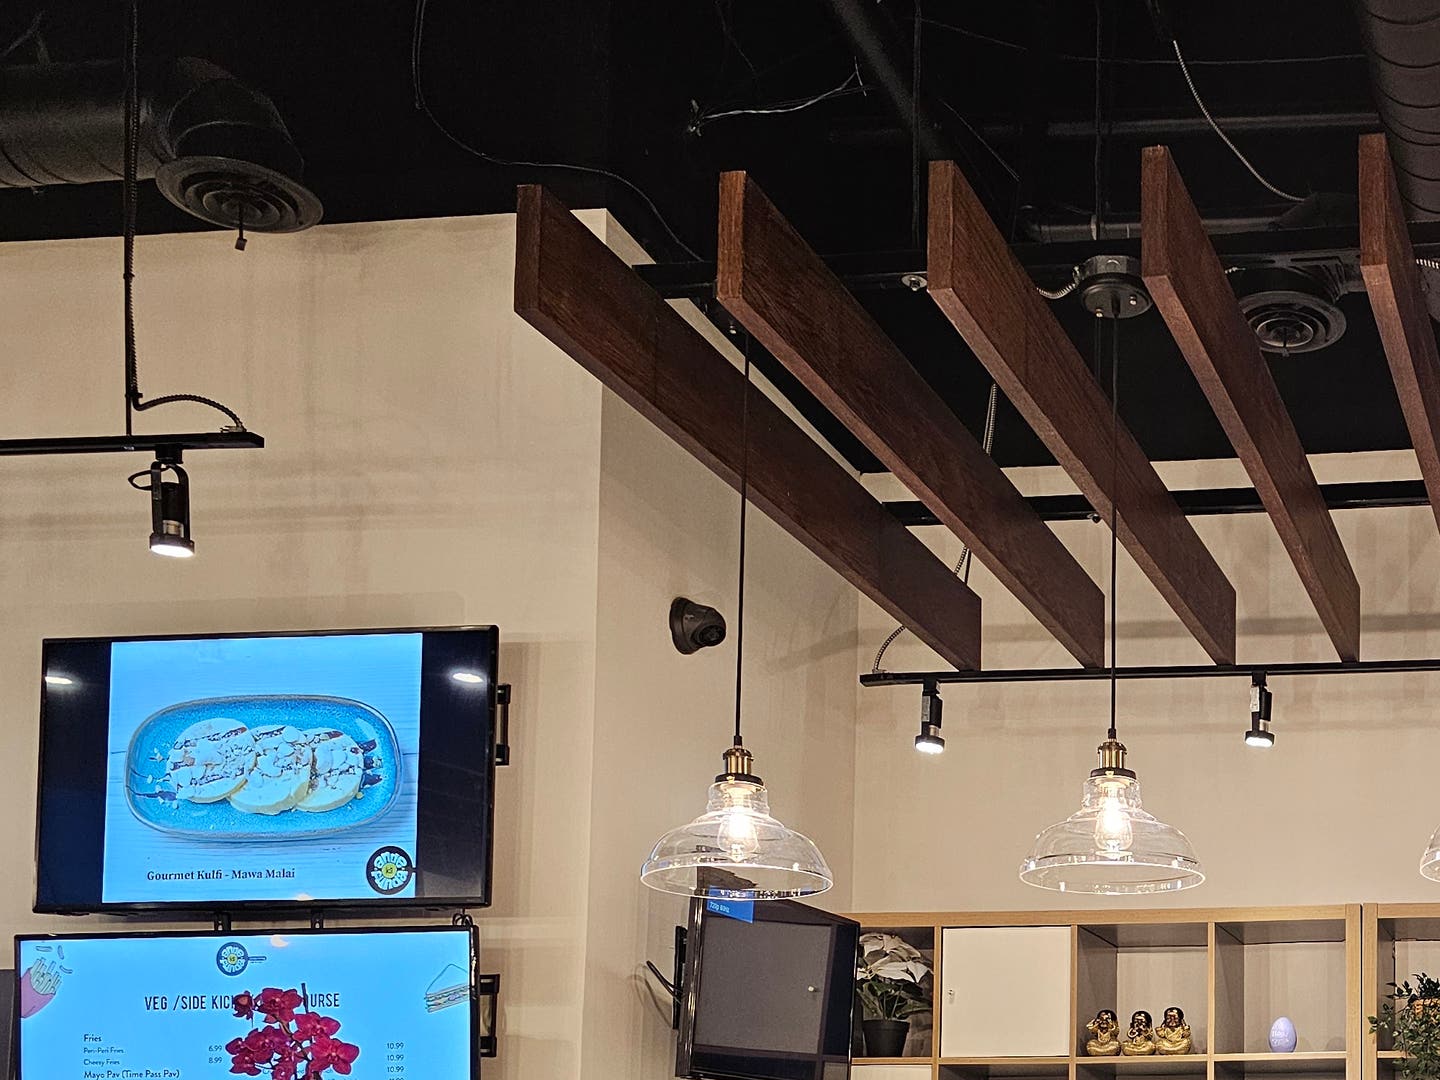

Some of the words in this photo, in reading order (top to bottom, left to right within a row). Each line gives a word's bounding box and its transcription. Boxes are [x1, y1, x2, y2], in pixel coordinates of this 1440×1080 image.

[147, 871, 194, 880] Gourmet
[197, 870, 222, 879] Kulfi
[231, 869, 263, 879] Mawa
[266, 868, 295, 879] Malai
[144, 996, 167, 1010] VEG
[172, 995, 207, 1011] /SIDE
[83, 1034, 102, 1042] Fries
[84, 1071, 105, 1080] Mayo
[107, 1070, 120, 1078] Pav
[122, 1069, 143, 1079] (Time
[145, 1070, 161, 1078] Pass
[163, 1069, 180, 1078] Pav)
